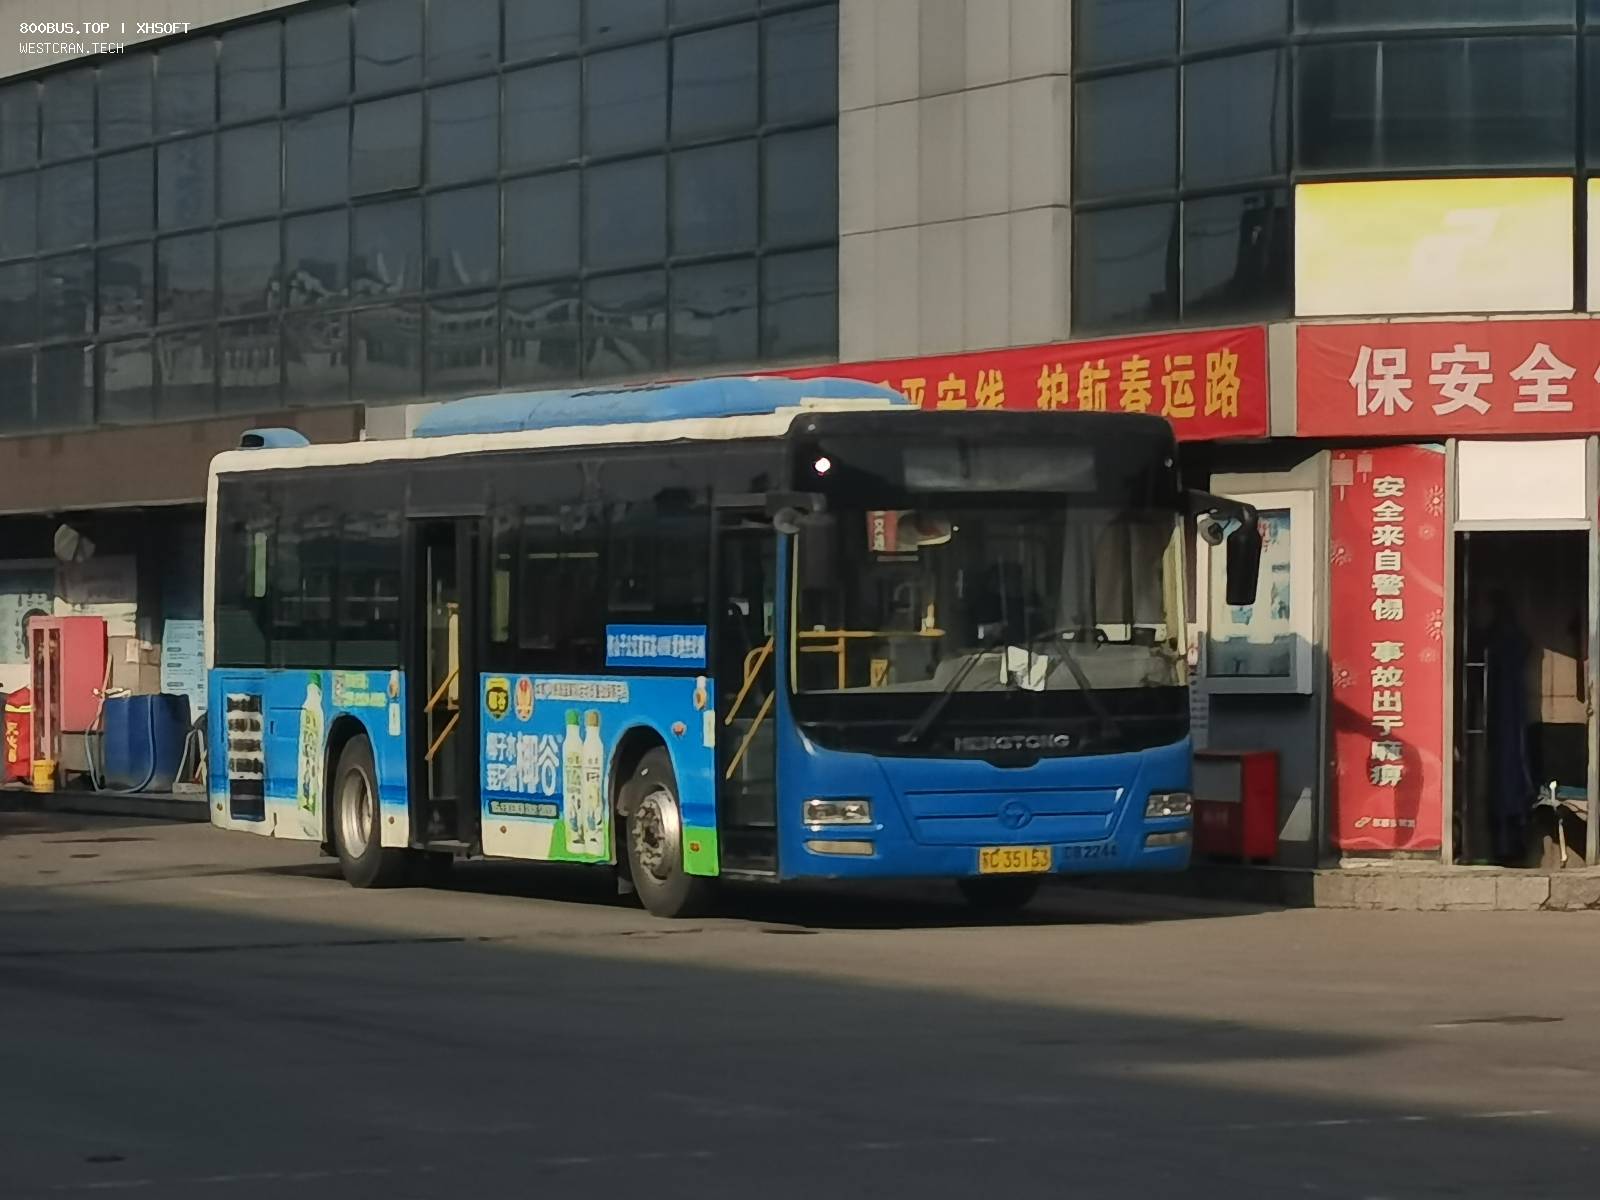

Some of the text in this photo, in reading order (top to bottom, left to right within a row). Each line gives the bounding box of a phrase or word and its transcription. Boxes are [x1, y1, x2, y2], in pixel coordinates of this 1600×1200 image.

[877, 347, 1242, 419] 平安线 护航春运路
[1348, 342, 1600, 417] 保安全
